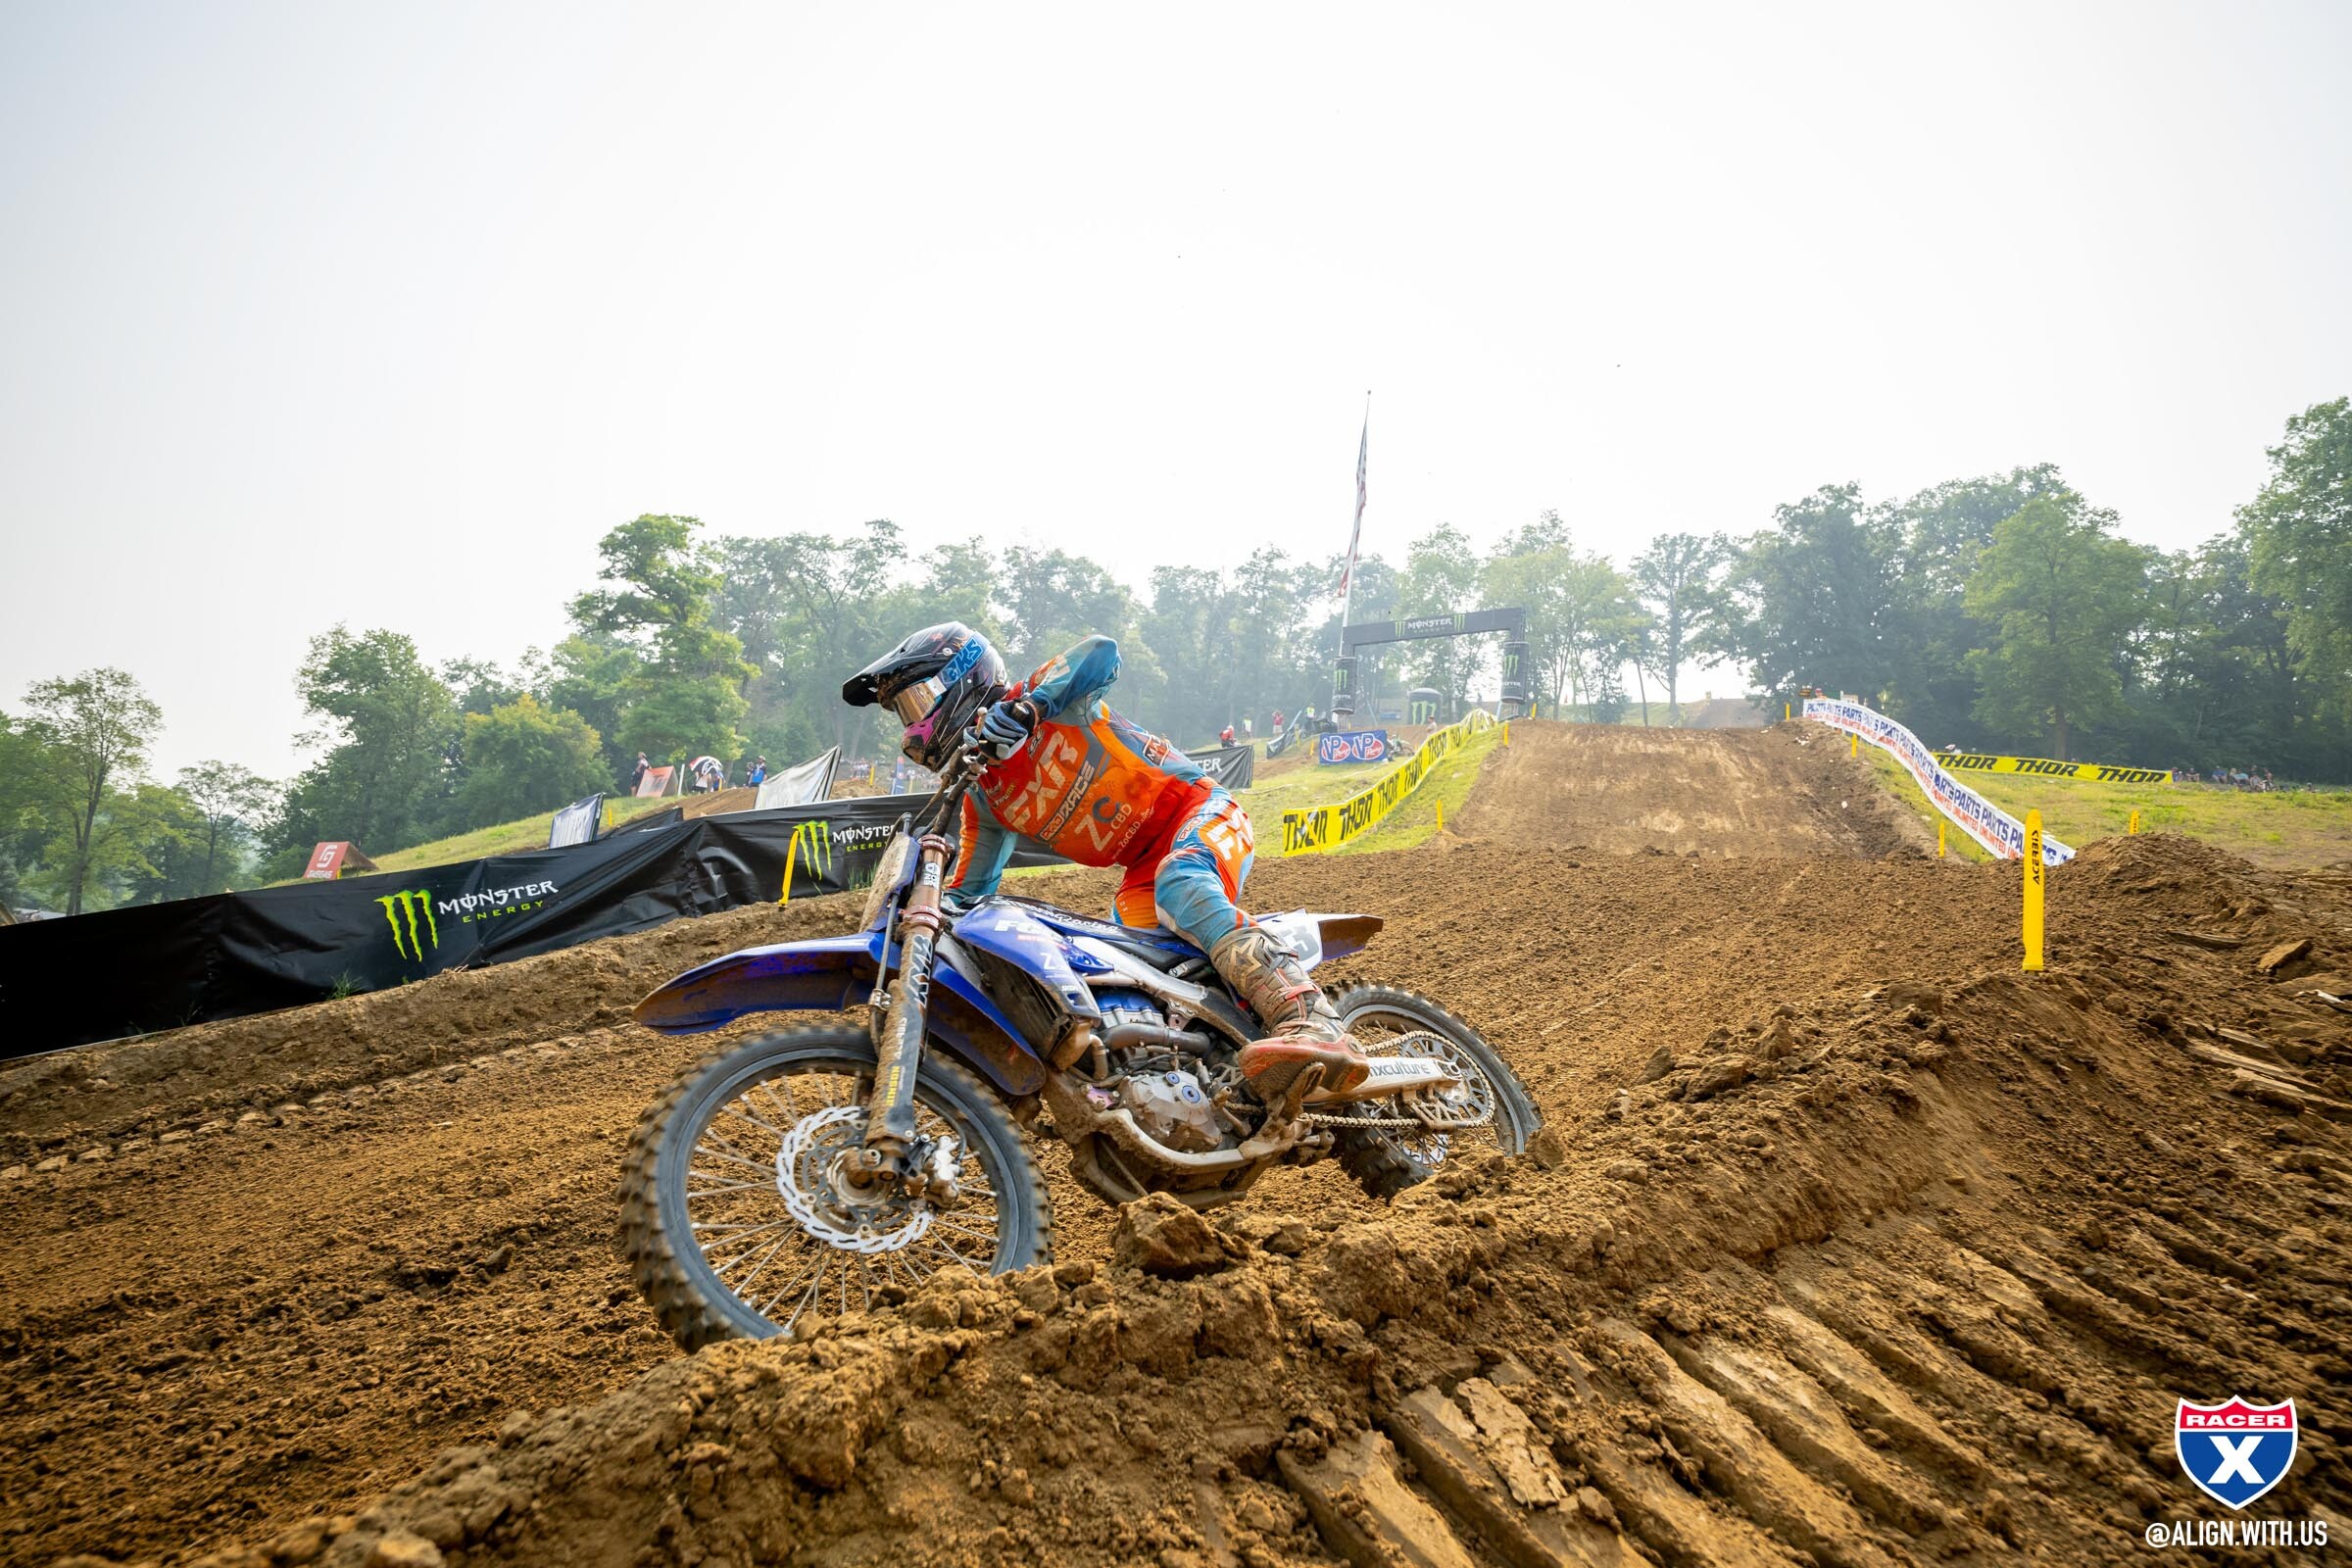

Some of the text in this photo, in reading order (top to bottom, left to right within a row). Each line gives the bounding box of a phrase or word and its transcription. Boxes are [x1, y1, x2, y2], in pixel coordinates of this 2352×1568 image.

[1003, 730, 1080, 835] FXR
[1936, 754, 1998, 770] THOR
[2014, 759, 2080, 777] THOR
[1061, 760, 1096, 819] RACE
[1378, 771, 1399, 814] THOR
[1109, 803, 1133, 831] CBD
[1284, 809, 1328, 852] THOR
[1339, 793, 1373, 841] THOR
[1954, 790, 1981, 819] PARTS
[1982, 808, 2009, 843] PARTS
[2032, 829, 2040, 885] ACERBIS
[437, 880, 560, 915] MONSTER
[462, 900, 544, 923] ENERGY
